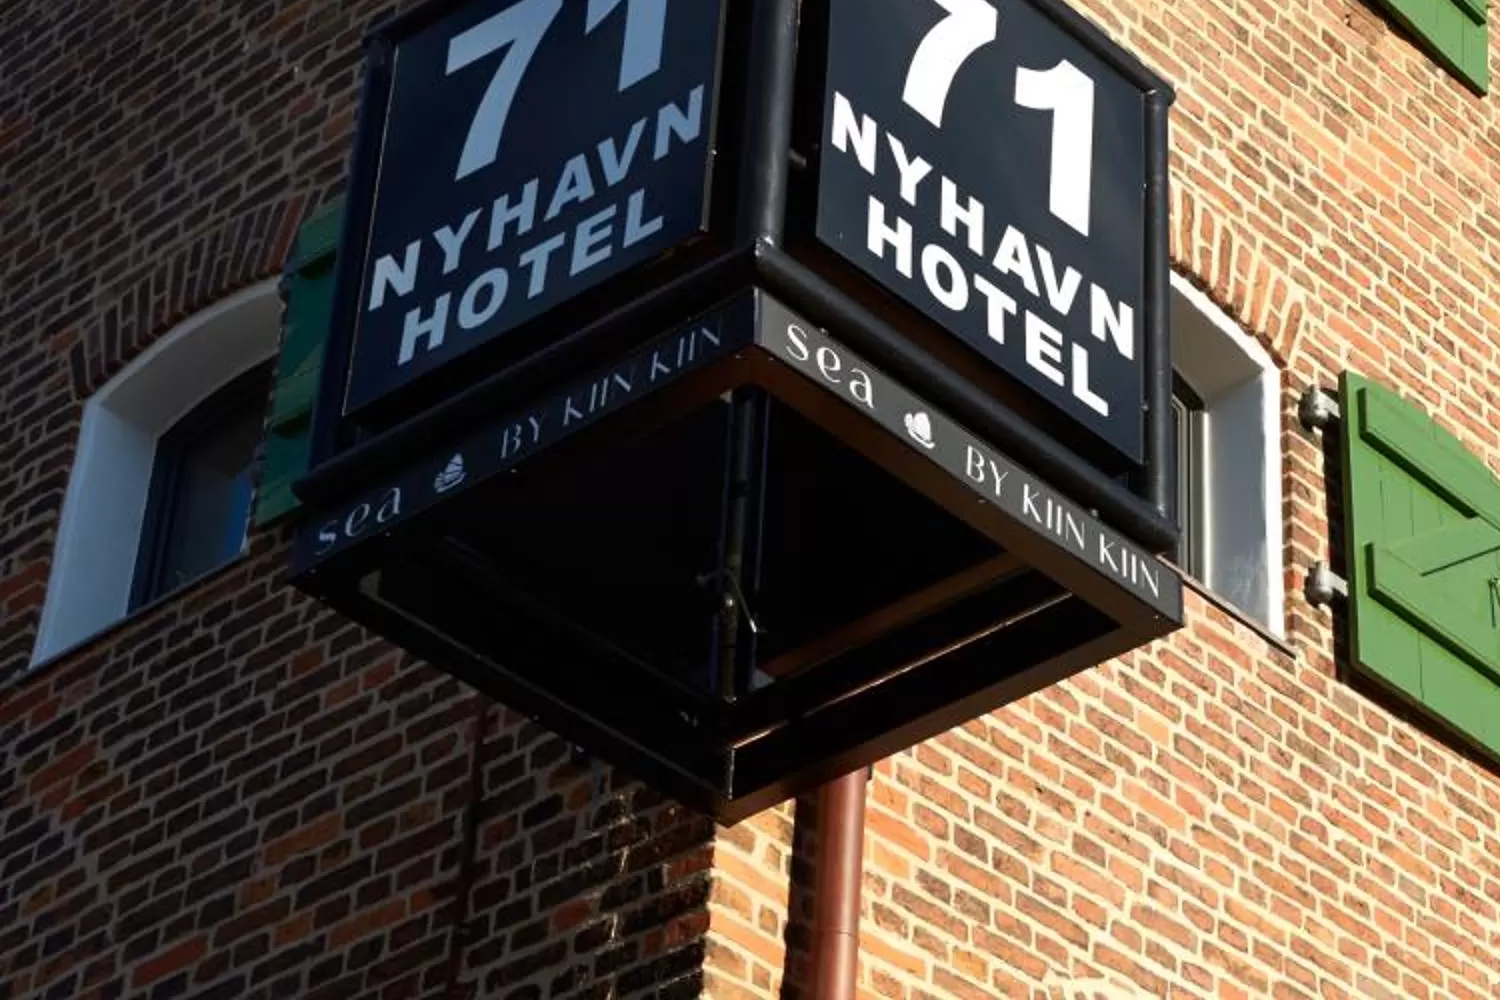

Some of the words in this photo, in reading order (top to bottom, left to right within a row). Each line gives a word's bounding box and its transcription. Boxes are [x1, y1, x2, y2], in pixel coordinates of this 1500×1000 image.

[368, 83, 705, 311] NYHAVN
[397, 188, 664, 366] HOTEL
[831, 91, 1134, 361] NYHAVN
[867, 196, 1109, 418] HOTEL
[315, 486, 401, 555] sea
[501, 415, 546, 459] BY
[562, 366, 640, 426] KIIN
[650, 318, 726, 382] KIIN
[787, 322, 875, 409] sea
[966, 445, 1009, 498] BY
[1023, 483, 1085, 552] KIIN
[1099, 533, 1161, 599] KIIN
